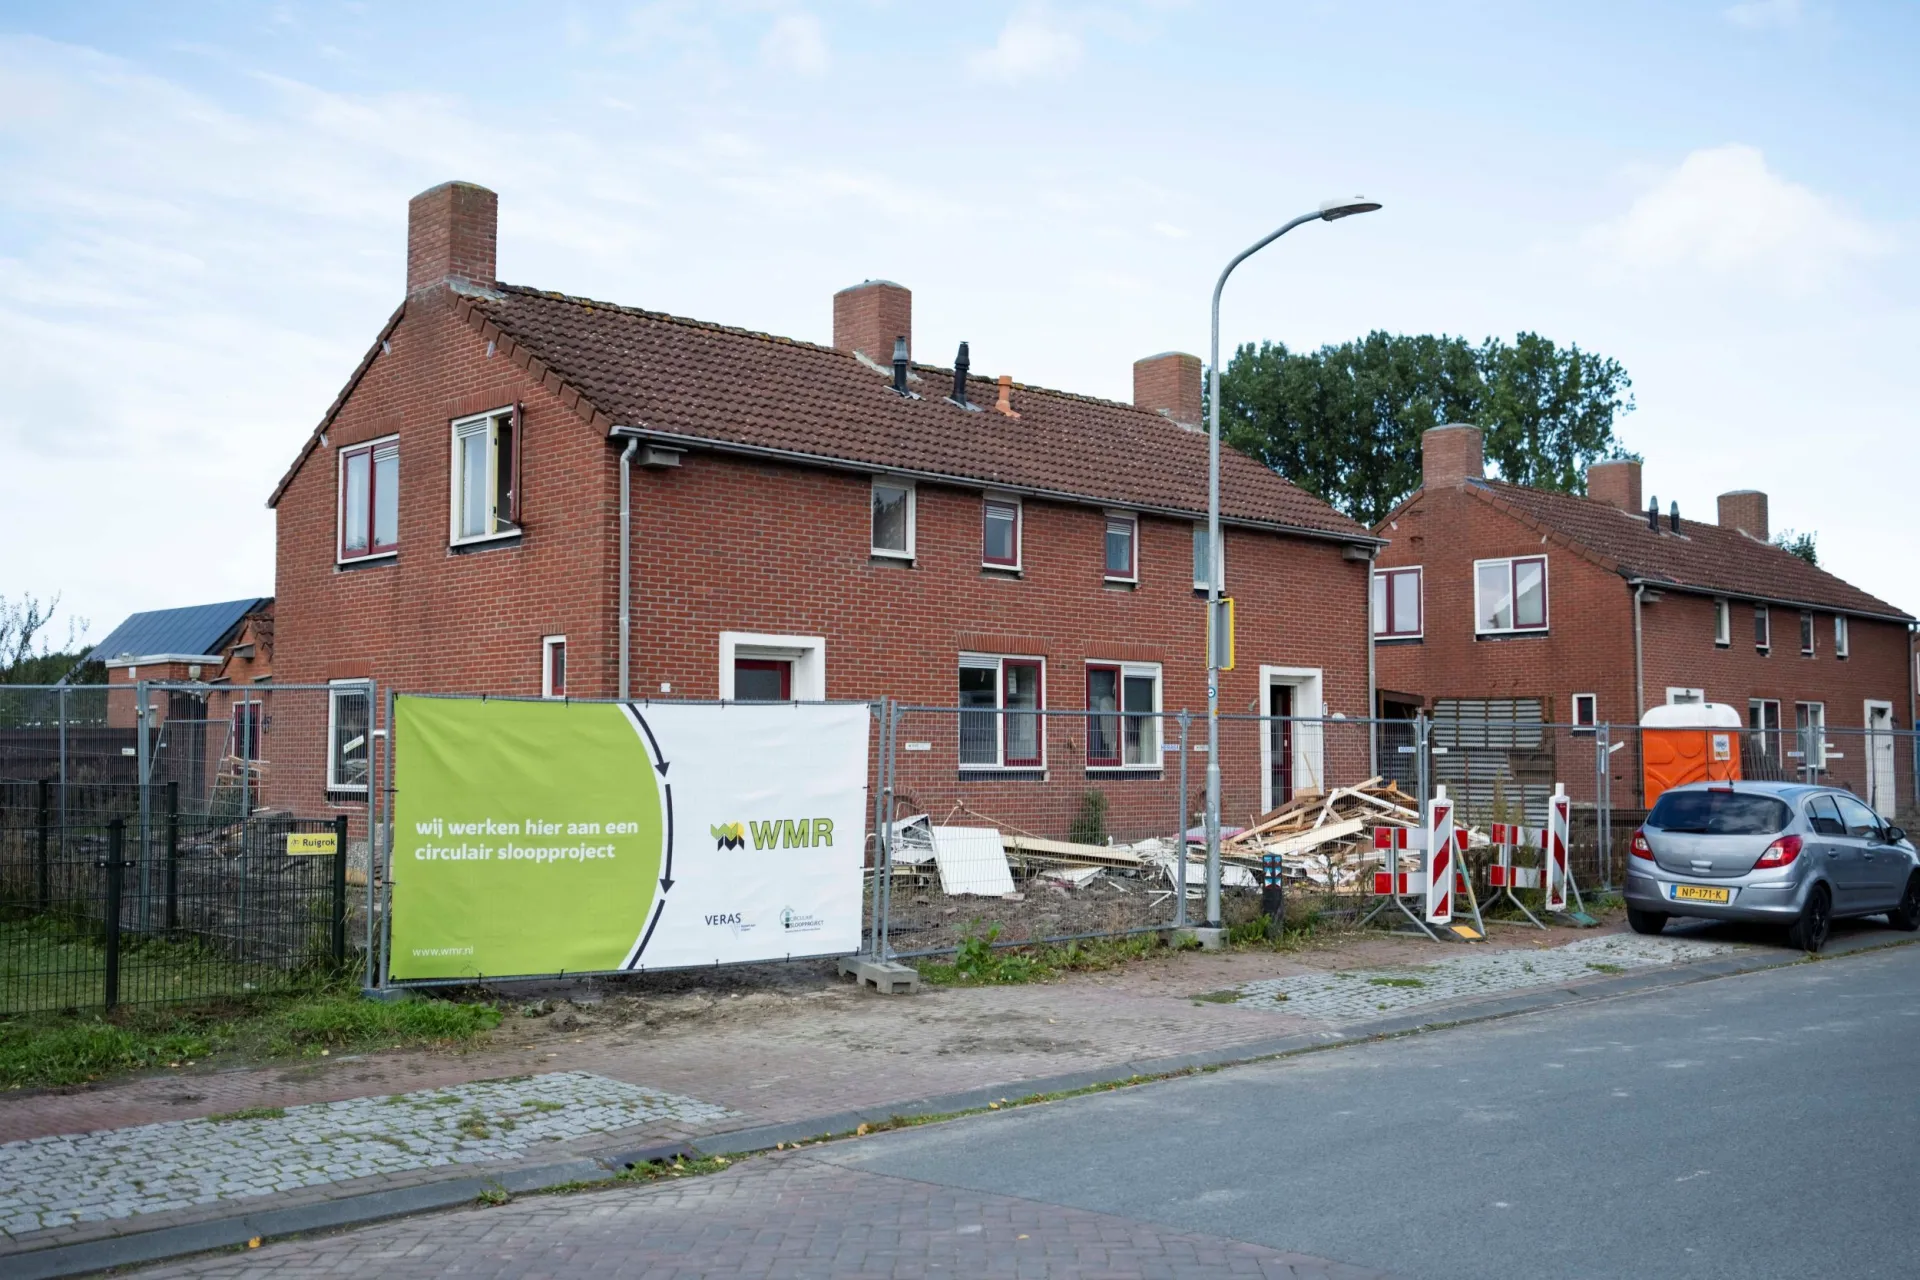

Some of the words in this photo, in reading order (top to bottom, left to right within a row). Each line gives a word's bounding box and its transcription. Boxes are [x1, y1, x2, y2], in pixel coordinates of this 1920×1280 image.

[416, 817, 443, 839] wij
[448, 817, 520, 835] werken
[525, 818, 563, 835] hier
[567, 822, 600, 835] aan
[605, 821, 638, 834] een
[749, 817, 834, 850] WMR
[302, 838, 336, 848] Ruigrok
[415, 842, 493, 860] circulair
[497, 841, 616, 863] sloopproject
[1682, 887, 1722, 899] NP-171-K
[705, 913, 741, 926] VERAS
[412, 944, 474, 957] www.wmr.nl
